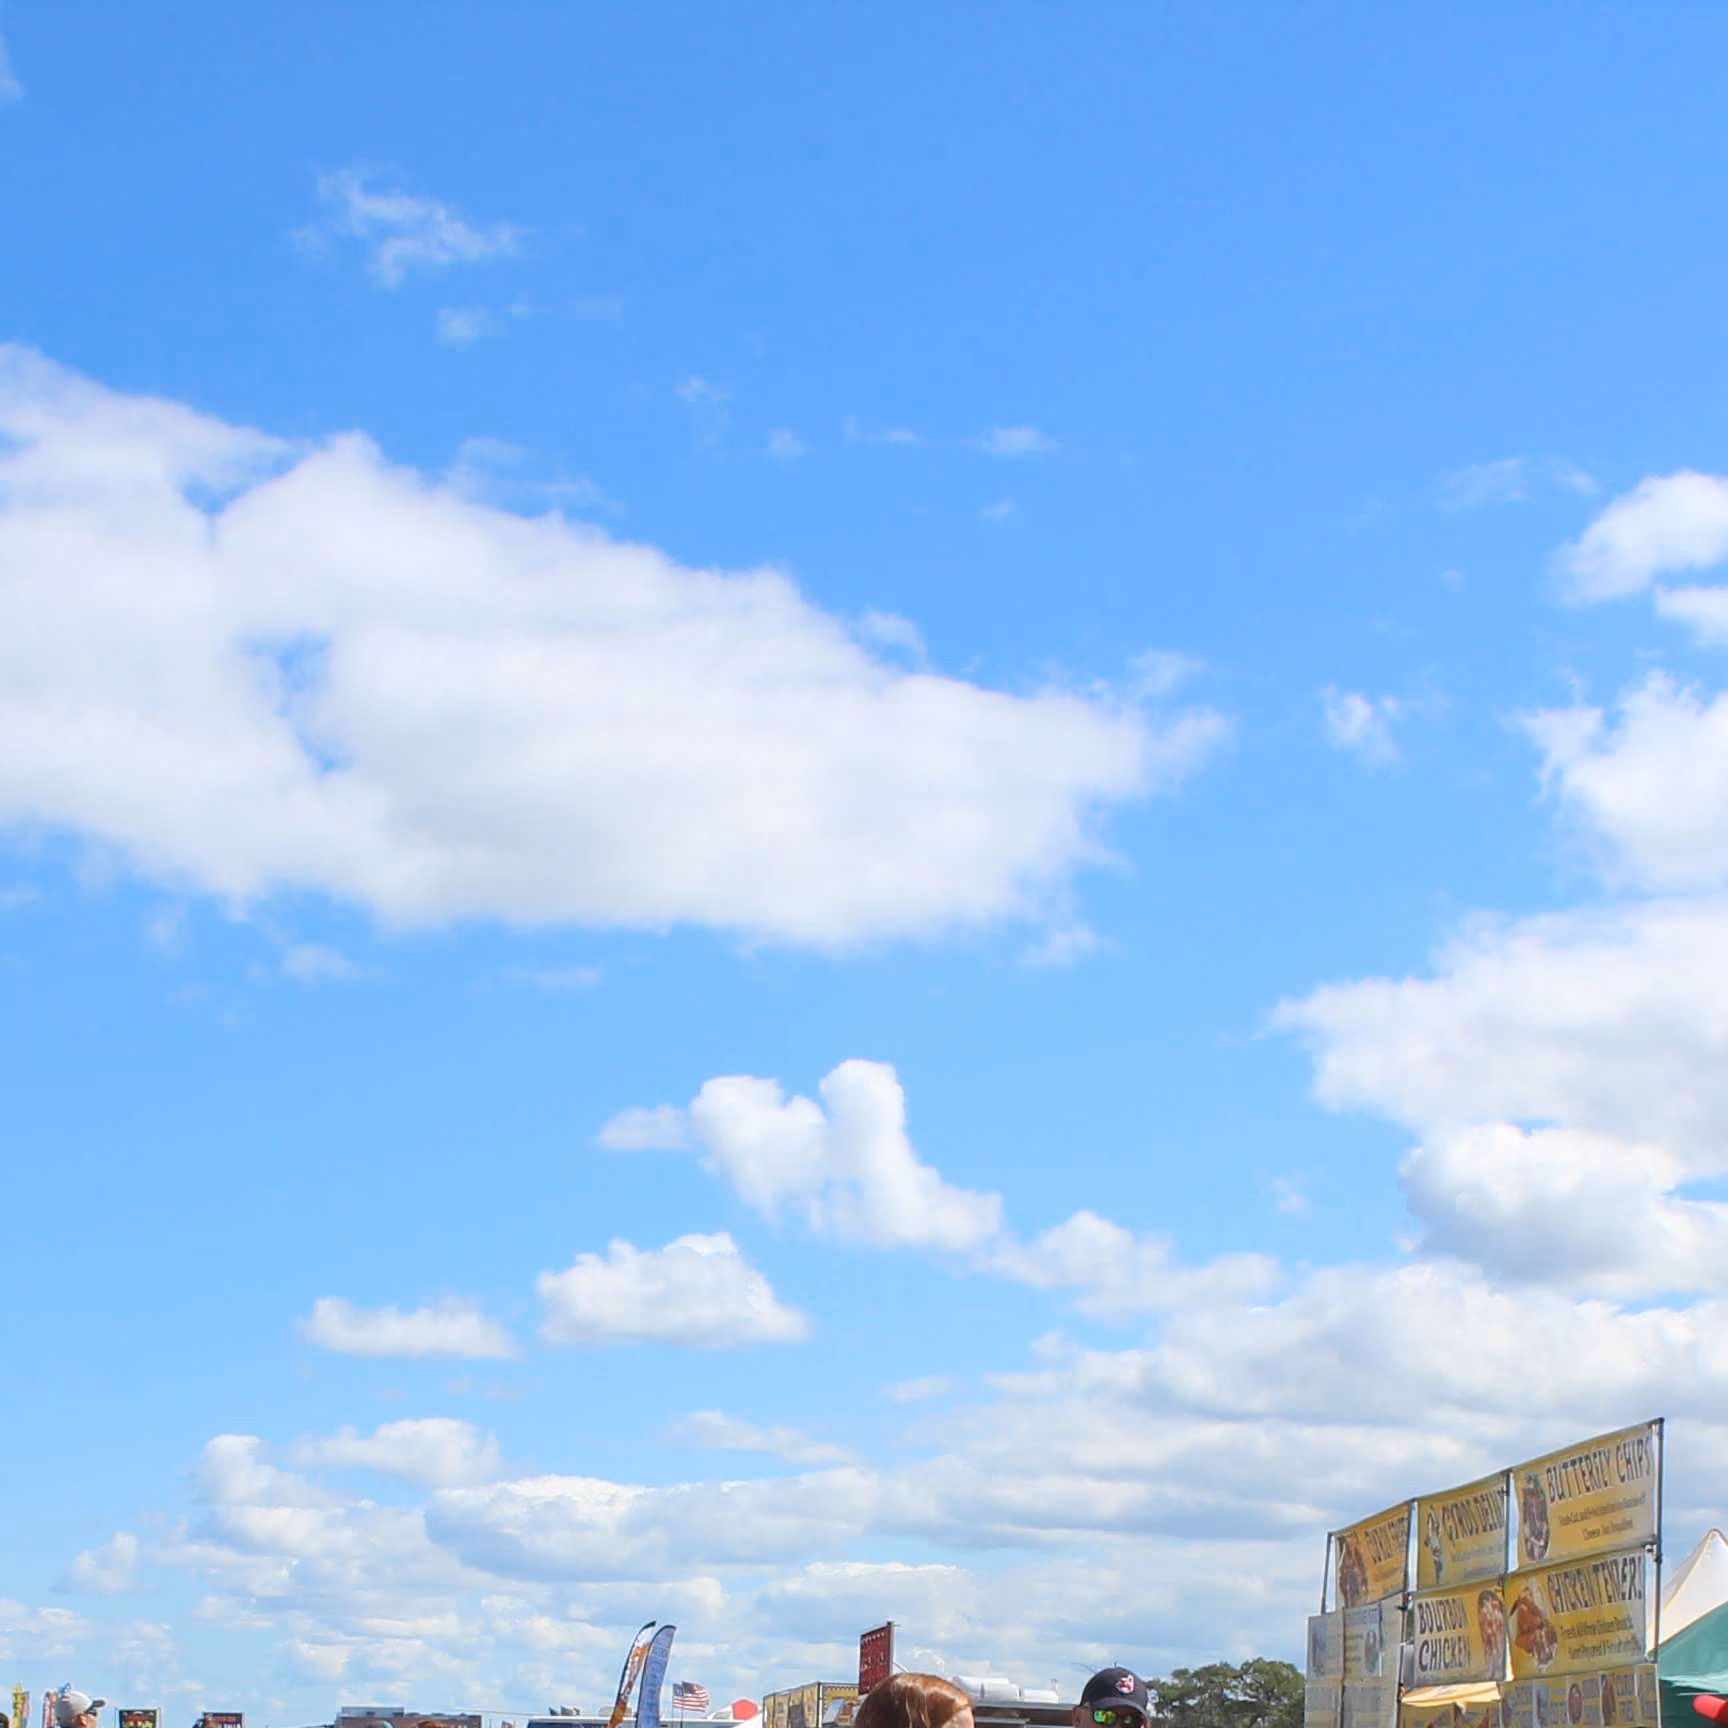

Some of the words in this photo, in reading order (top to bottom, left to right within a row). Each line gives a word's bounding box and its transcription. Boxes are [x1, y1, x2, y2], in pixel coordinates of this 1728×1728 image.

[1545, 1448, 1611, 1505] BUTTERFLY
[1615, 1434, 1652, 1484] CHIPS
[1417, 1598, 1469, 1635] BOURBON
[1419, 1635, 1471, 1672] CHICKEN
